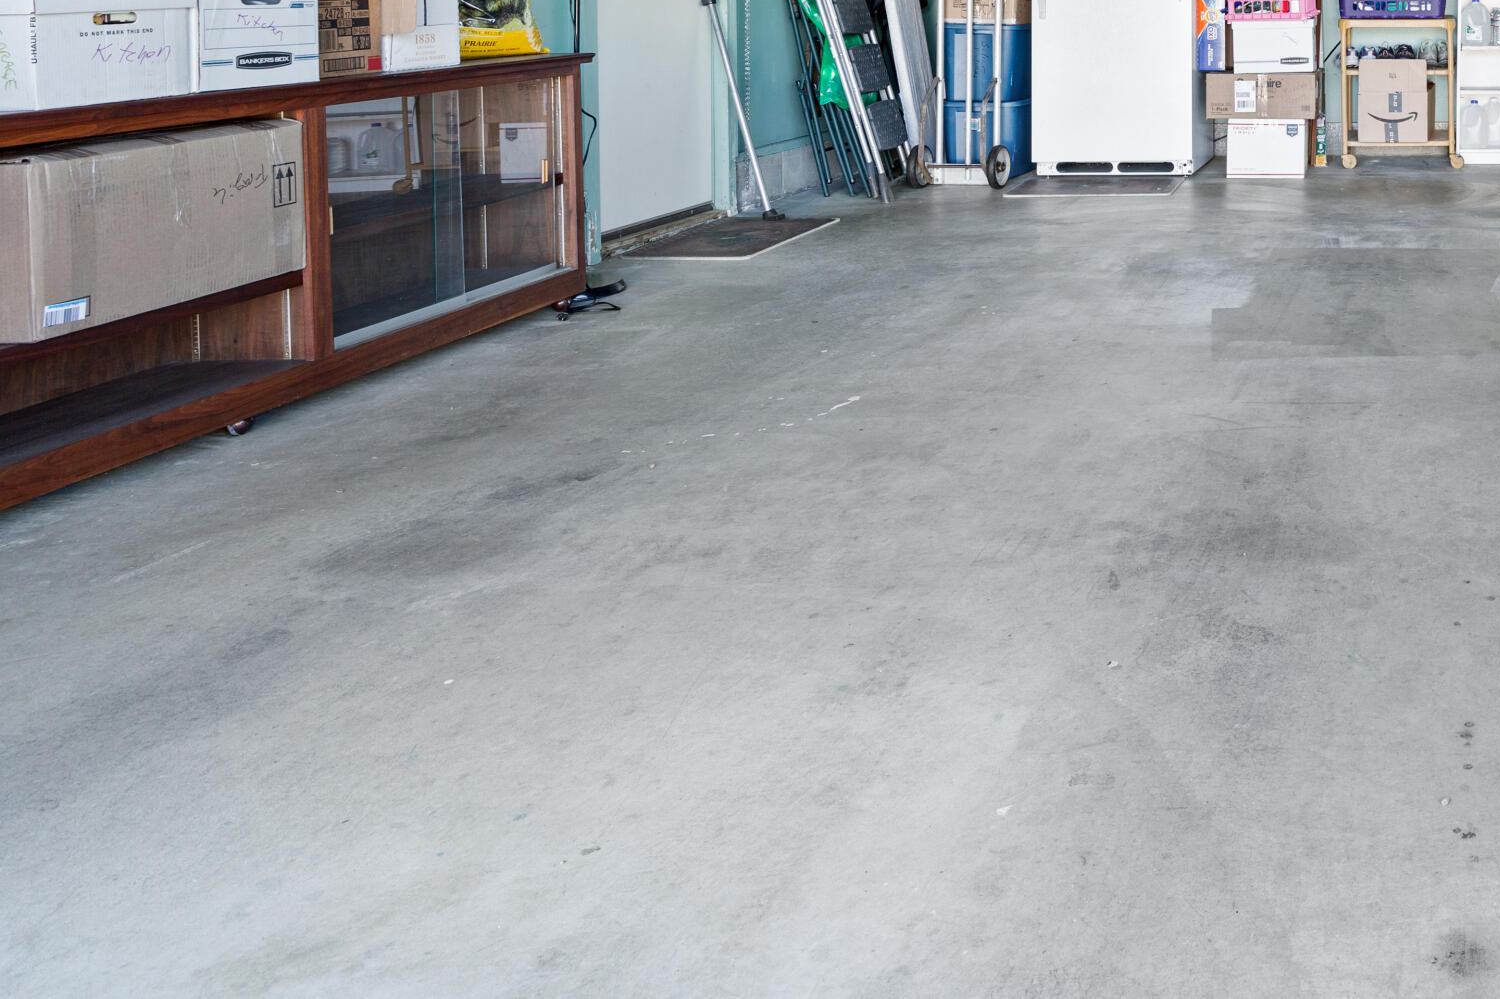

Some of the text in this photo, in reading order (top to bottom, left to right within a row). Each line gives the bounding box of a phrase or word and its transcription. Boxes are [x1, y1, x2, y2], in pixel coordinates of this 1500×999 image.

[236, 13, 284, 41] Kitchen
[464, 39, 497, 47] PRAIRIE
[239, 56, 290, 65] BANKERS BOX
